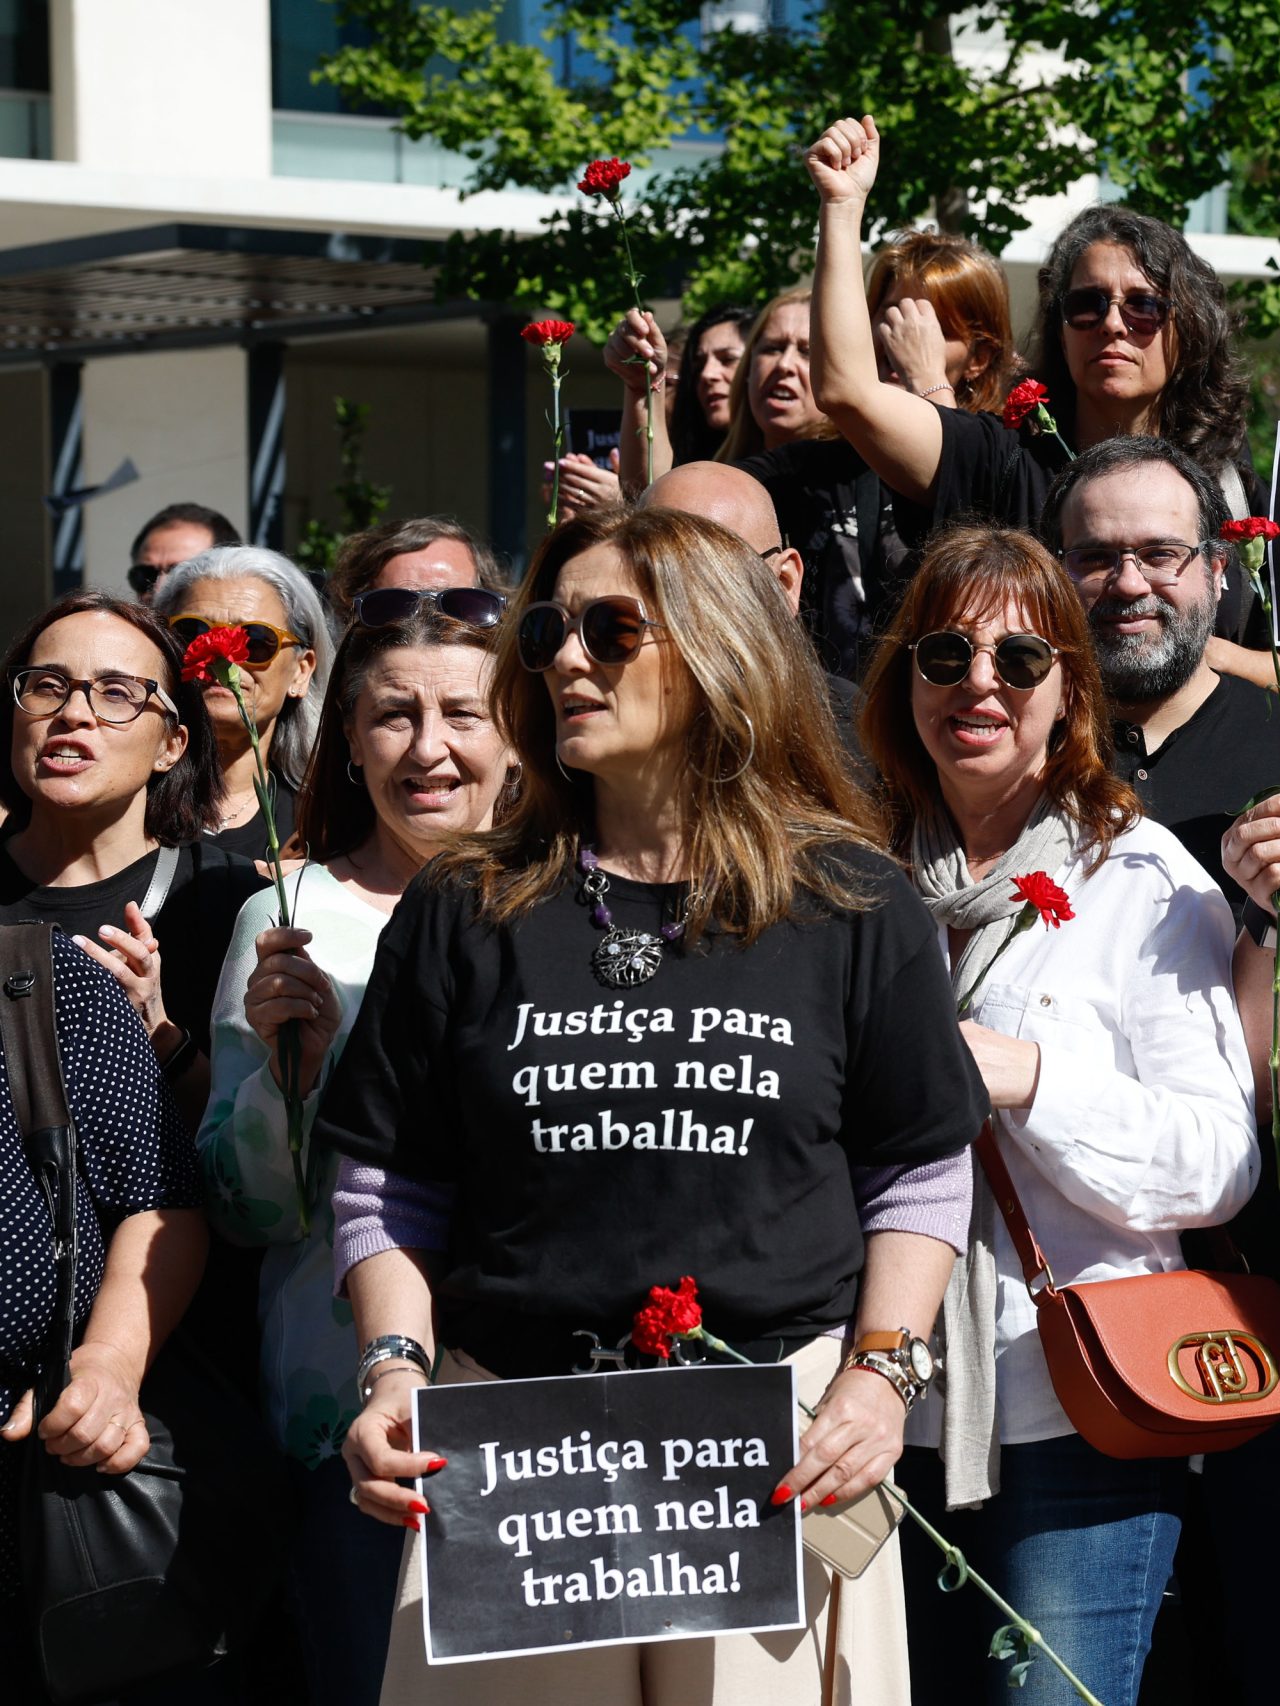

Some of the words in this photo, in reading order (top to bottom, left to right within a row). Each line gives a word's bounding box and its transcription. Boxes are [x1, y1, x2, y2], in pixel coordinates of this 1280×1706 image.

[507, 1000, 675, 1051] Justiça
[688, 1006, 794, 1046] para
[512, 1060, 658, 1106] quem
[673, 1054, 781, 1100] nela
[530, 1108, 754, 1157] trabalha!
[479, 1430, 648, 1497] Justiça
[660, 1437, 769, 1481] para
[498, 1501, 642, 1557] quem
[654, 1485, 760, 1532] nela
[521, 1551, 741, 1607] trabalha!
